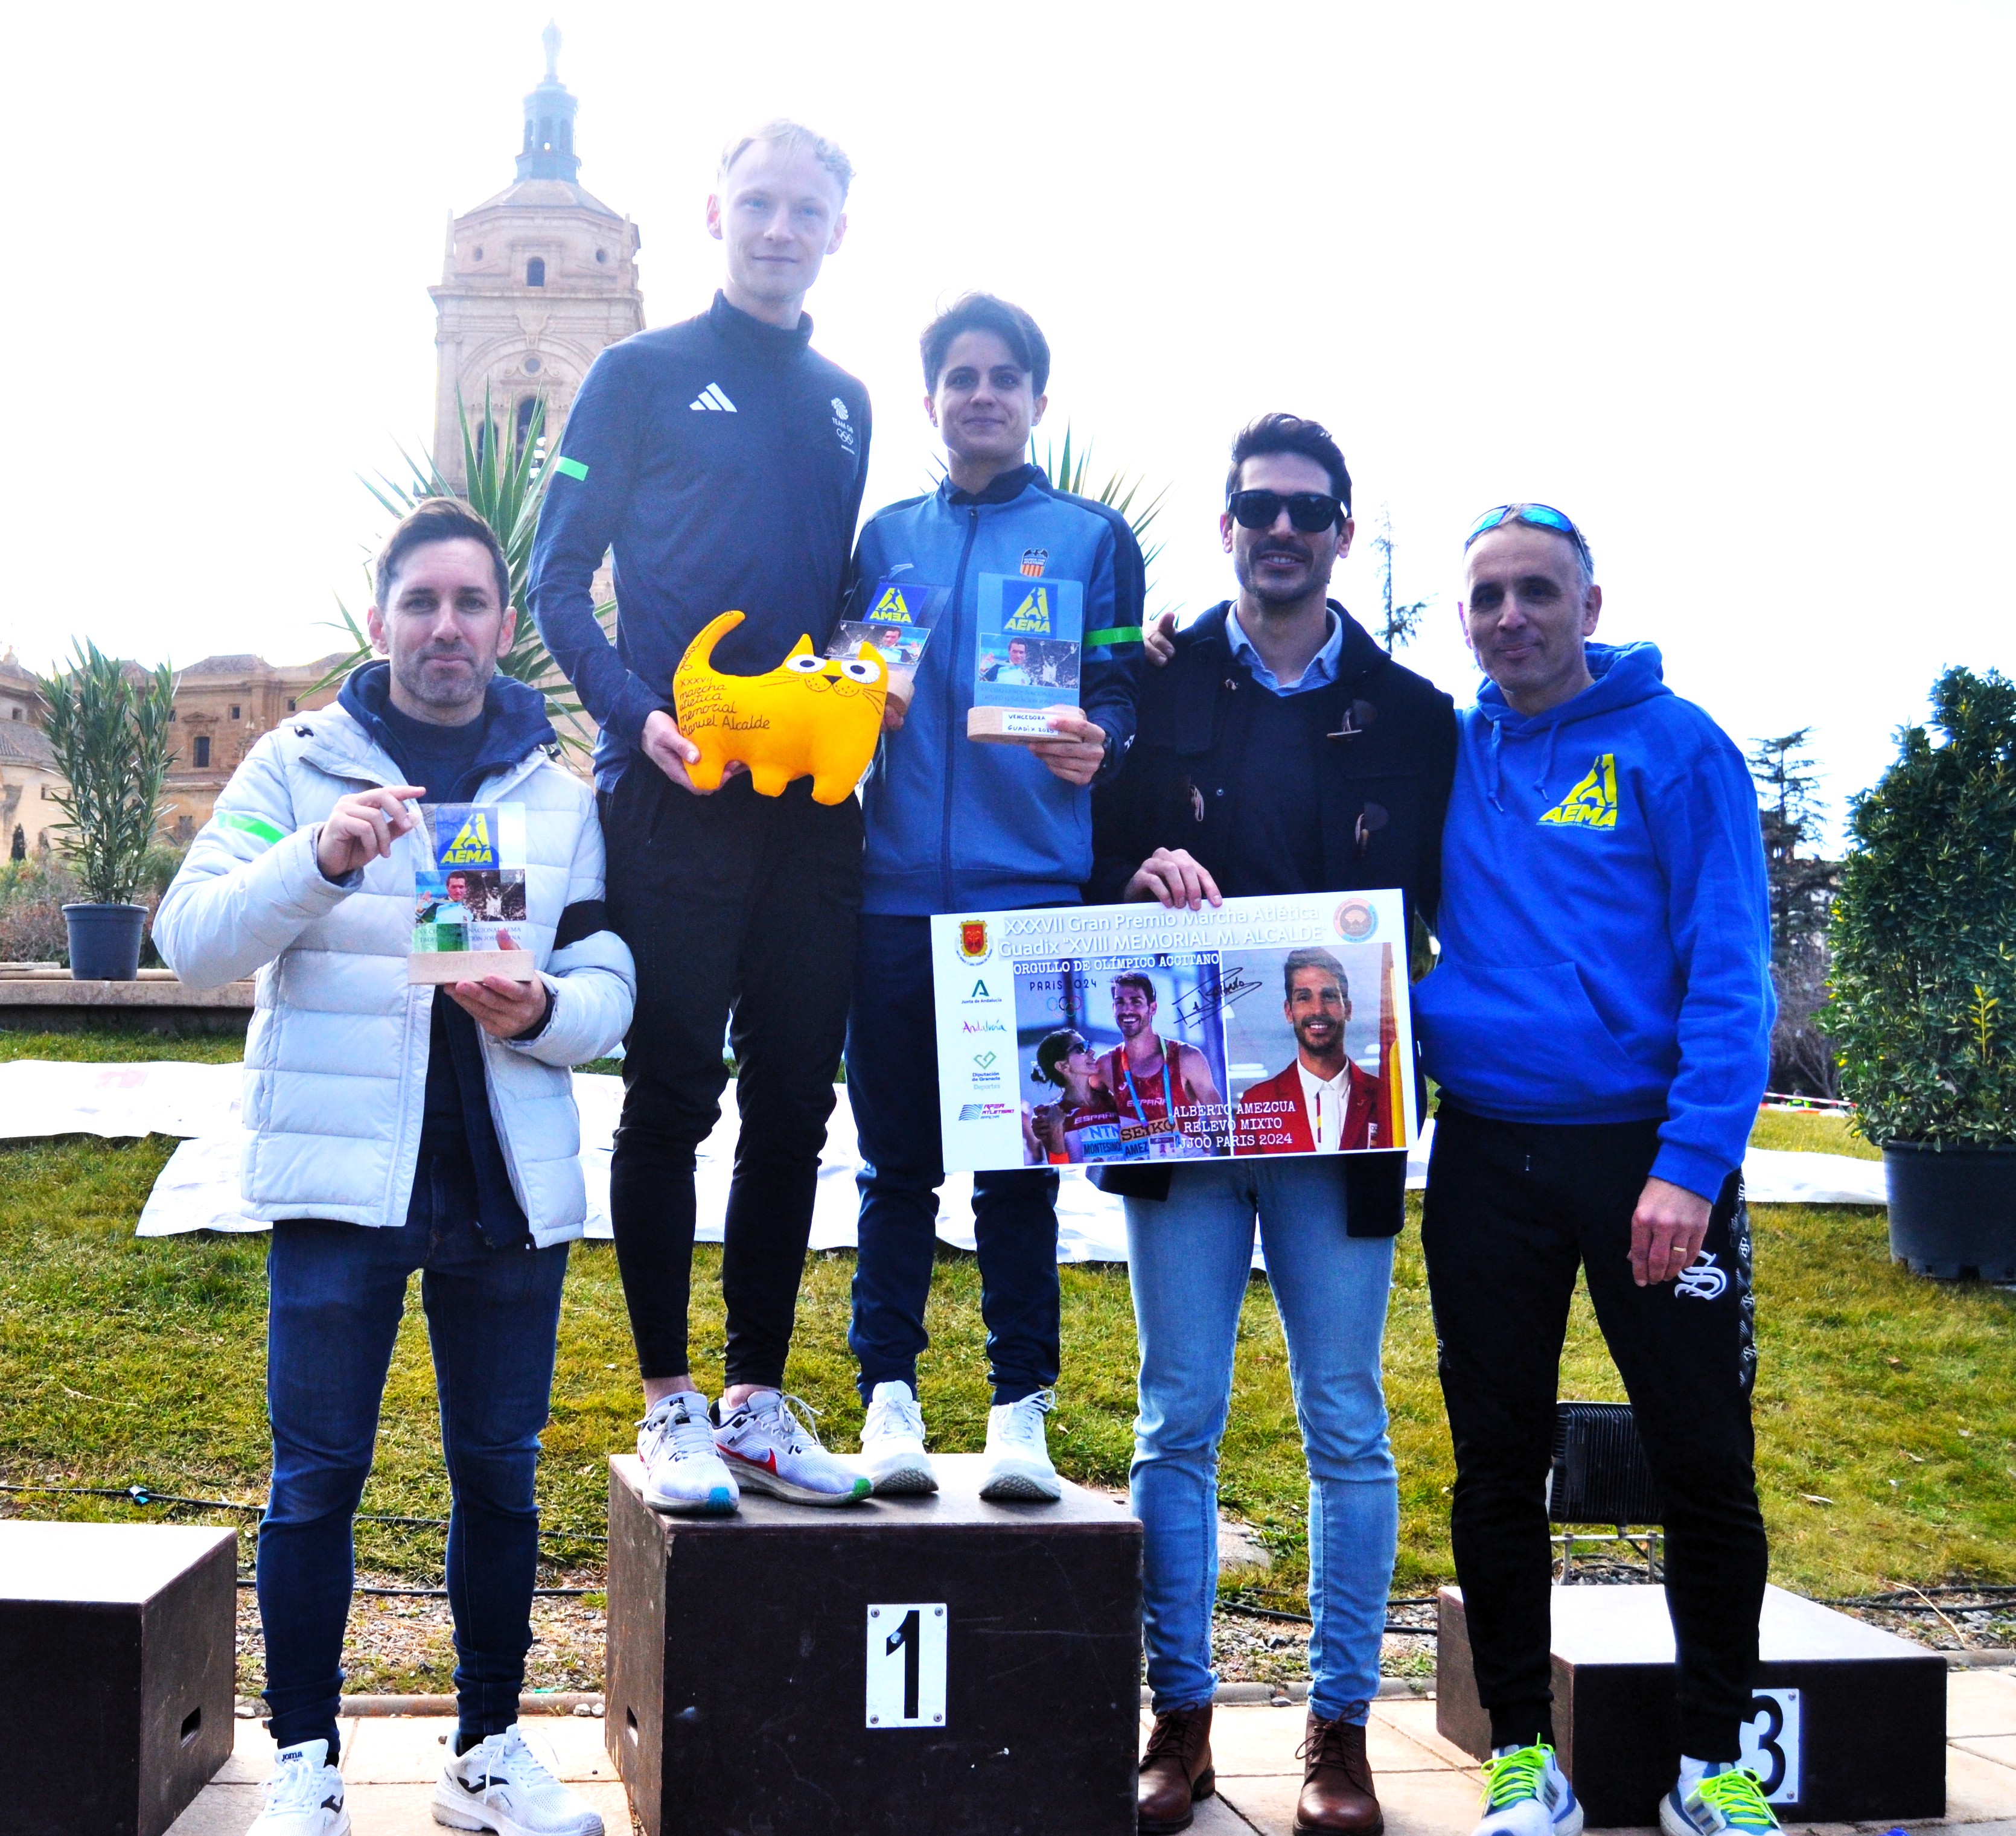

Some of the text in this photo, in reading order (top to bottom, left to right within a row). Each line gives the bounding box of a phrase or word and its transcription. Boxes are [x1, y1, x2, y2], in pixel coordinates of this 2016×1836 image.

[1004, 617, 1051, 633] AEMA
[680, 701, 737, 724] memorial
[681, 715, 770, 738] Manuel Alcalde
[1539, 803, 1618, 827] AEMA
[441, 849, 493, 864] AEMA
[1004, 917, 1064, 936] XXXVII
[1068, 916, 1110, 932] Gran
[1115, 912, 1176, 929] Premio
[1178, 907, 1248, 926] Marcha
[1251, 905, 1319, 923] Atlética
[998, 937, 1059, 957] Guadix
[1063, 936, 1108, 954] "XVIII
[1114, 931, 1212, 952] MEMORIAL
[1217, 930, 1238, 945] M.
[1013, 954, 1220, 975] ORGULLO DE OLÍMPICO ACCITANO
[1173, 1101, 1296, 1118] ALBERTO AMEZCUA
[1184, 1117, 1283, 1133] RELEVO MIXTO
[1179, 1137, 1212, 1149] JJOO
[1216, 1135, 1255, 1147] PARIS
[1259, 1133, 1293, 1146] 2024
[885, 1610, 920, 1719] 1
[1741, 1694, 1787, 1798] 3
